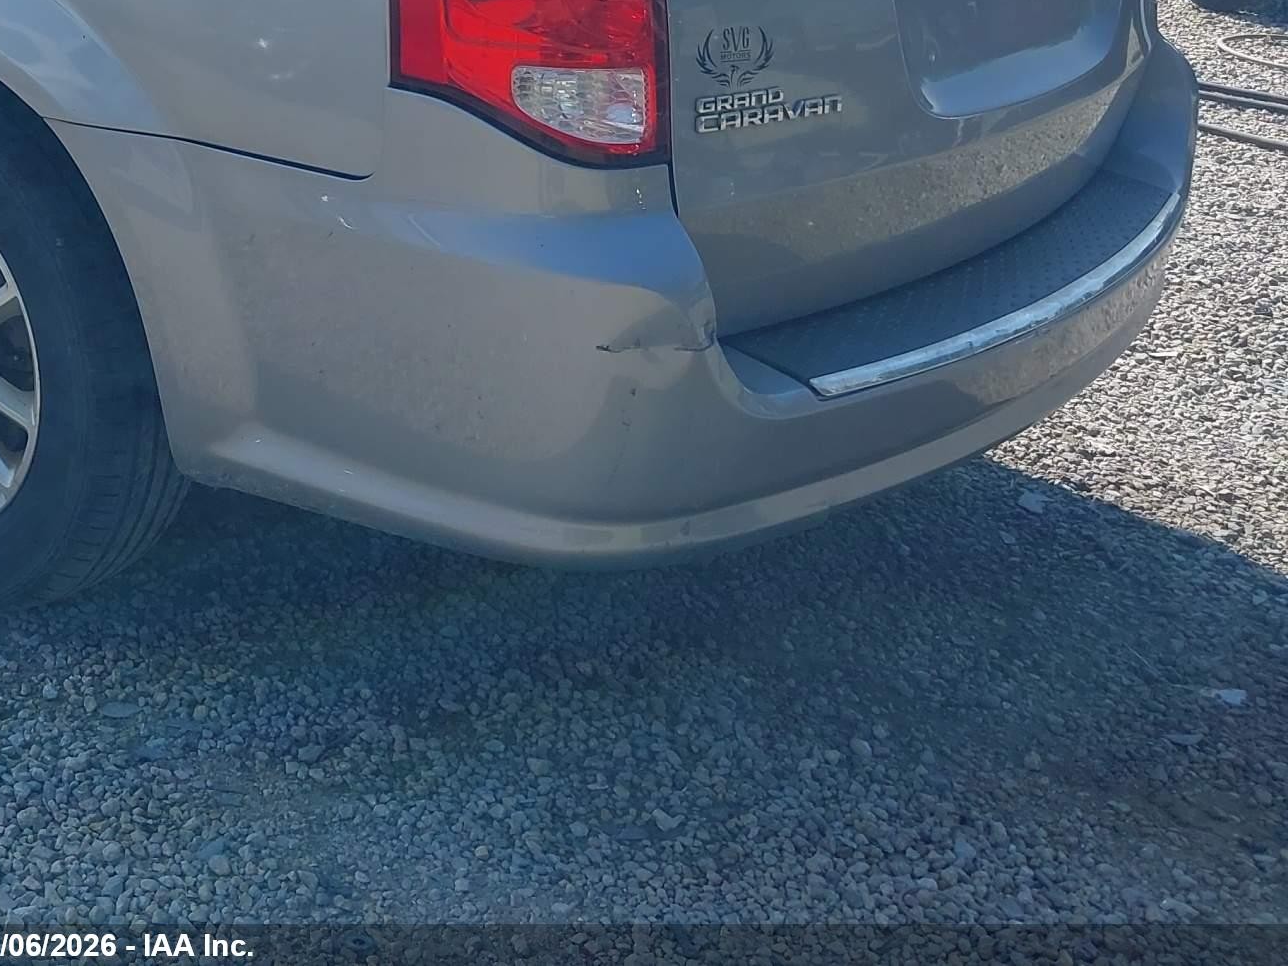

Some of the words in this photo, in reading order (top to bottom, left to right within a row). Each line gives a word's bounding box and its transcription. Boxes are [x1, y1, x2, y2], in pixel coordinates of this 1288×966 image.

[720, 52, 751, 60] MOTORS
[697, 87, 784, 113] GRAND
[697, 95, 842, 133] CARAVAN
